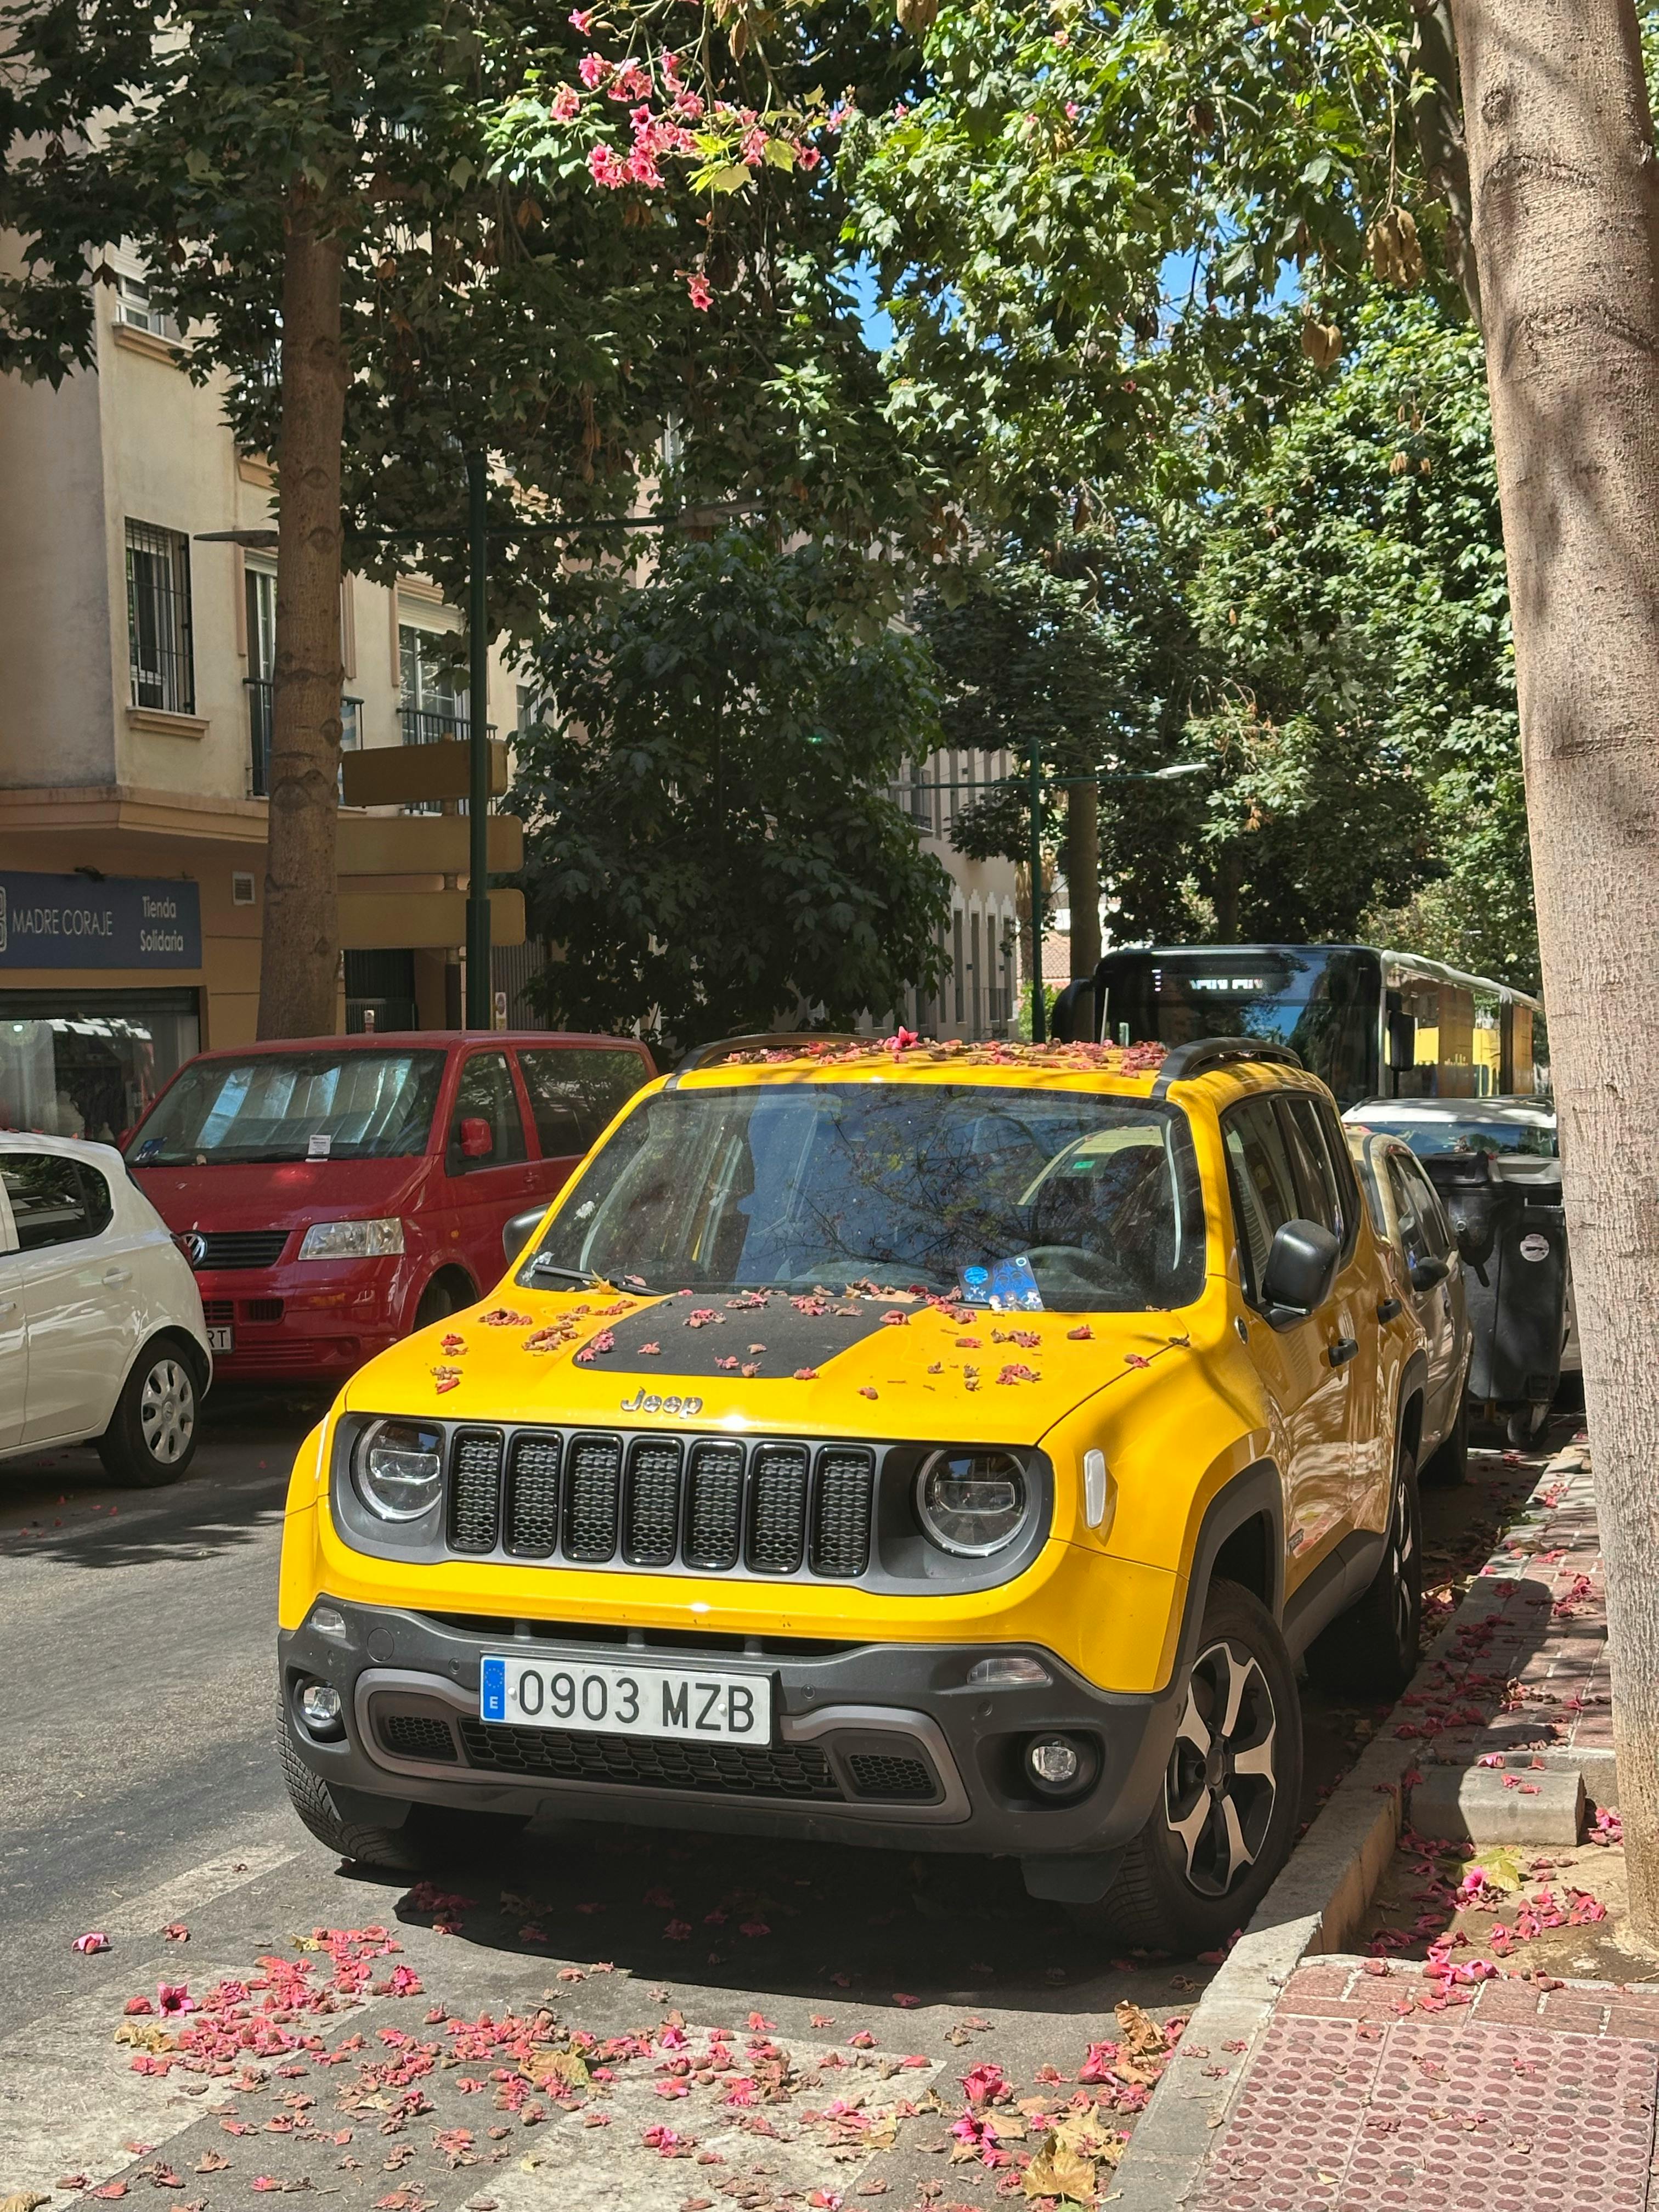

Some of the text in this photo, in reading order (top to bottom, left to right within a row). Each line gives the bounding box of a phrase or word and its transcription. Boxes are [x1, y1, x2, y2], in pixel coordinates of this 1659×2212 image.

[142, 896, 177, 918] Tienda
[12, 908, 113, 935] MADRE CORAJE
[140, 930, 184, 951] Solidaria
[620, 1386, 703, 1419] Jeep
[489, 1696, 498, 1709] E
[519, 1669, 754, 1733] 0903 MZB
